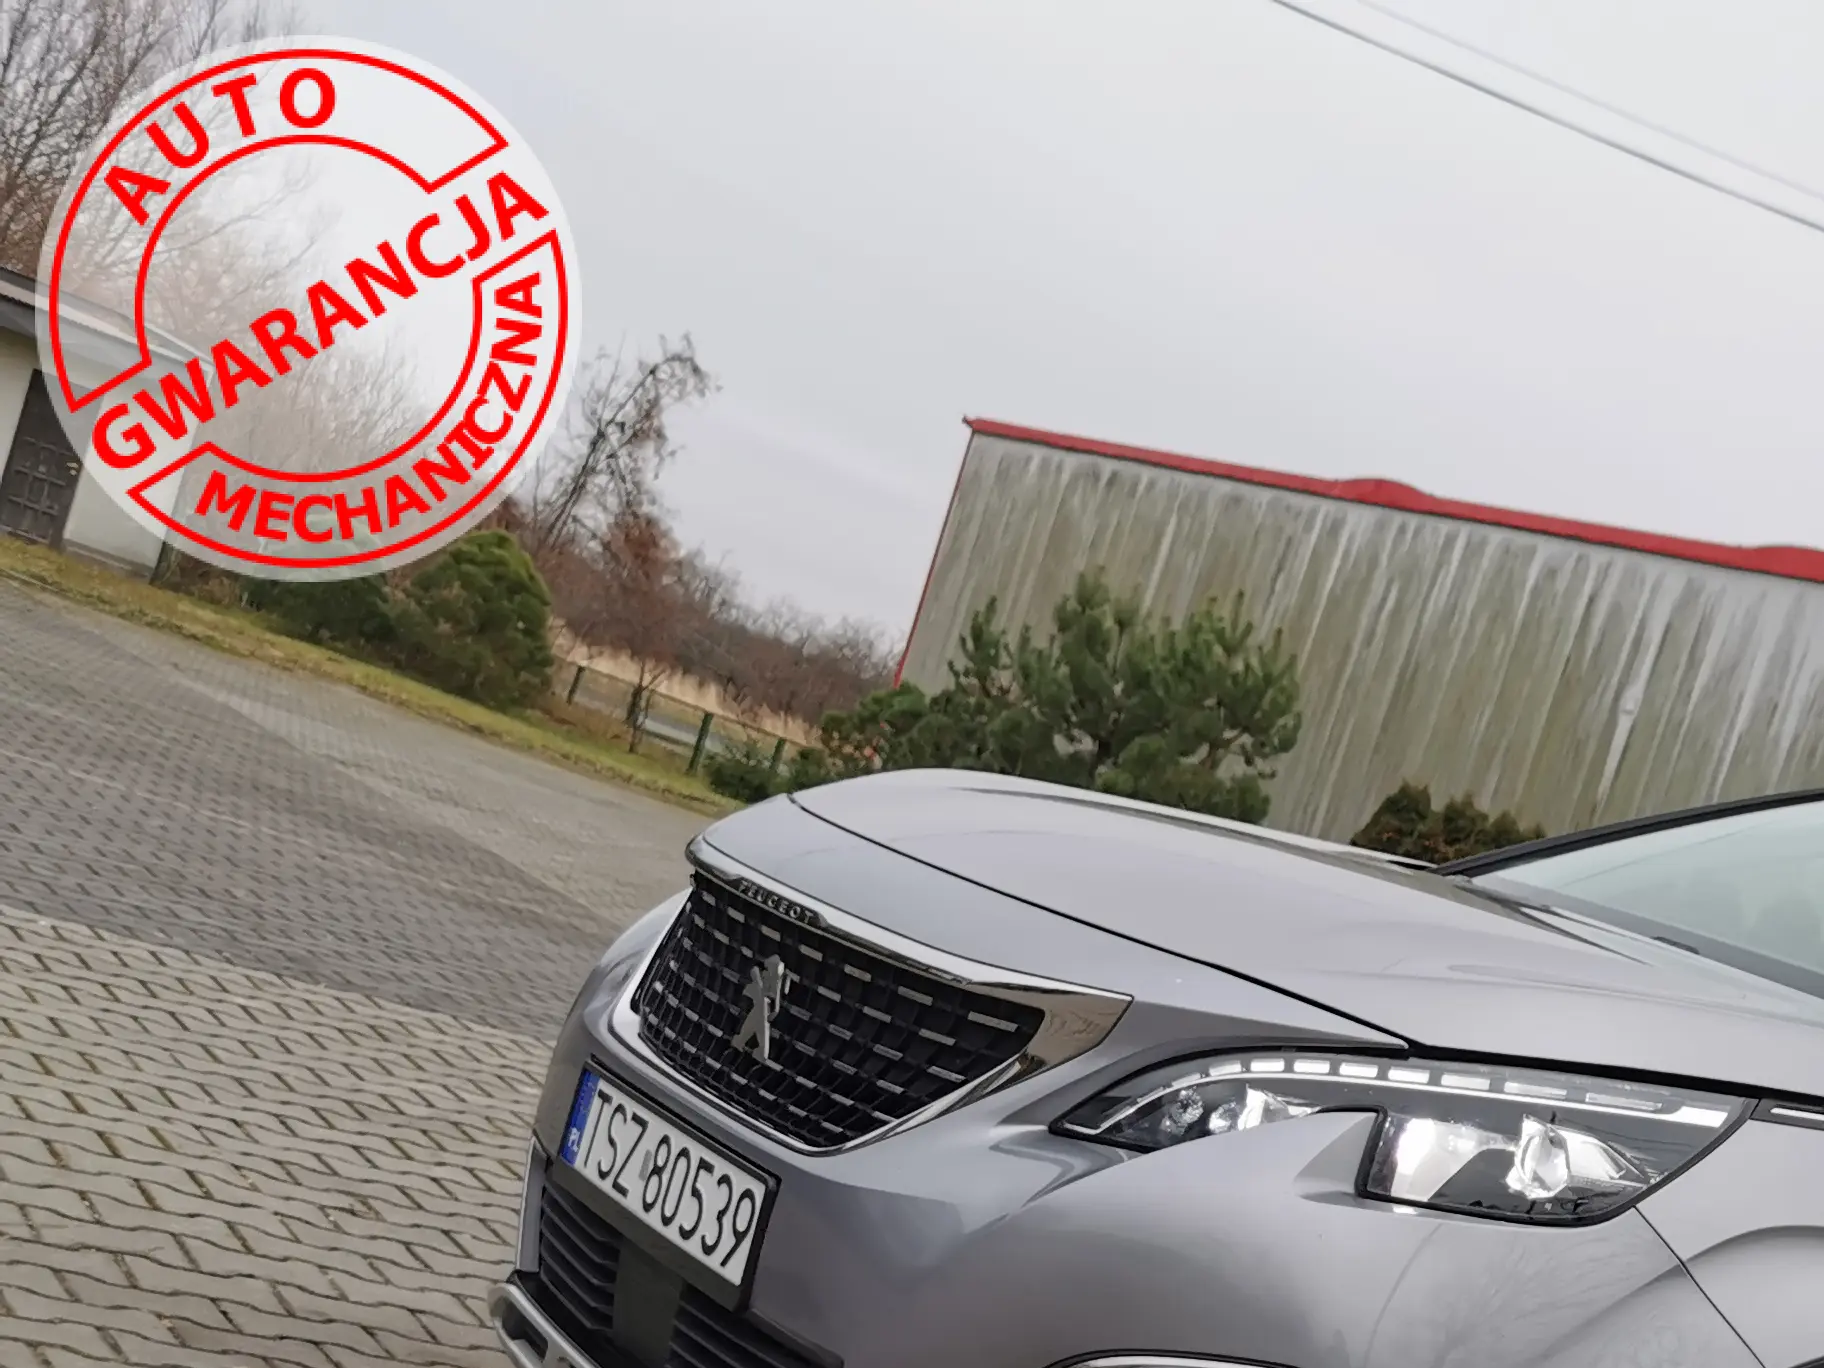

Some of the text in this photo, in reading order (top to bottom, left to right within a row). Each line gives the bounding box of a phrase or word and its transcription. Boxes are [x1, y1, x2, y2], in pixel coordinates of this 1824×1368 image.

[739, 880, 814, 924] PEUGEOT
[584, 1090, 649, 1199] TSZ
[642, 1134, 756, 1268] 80539
